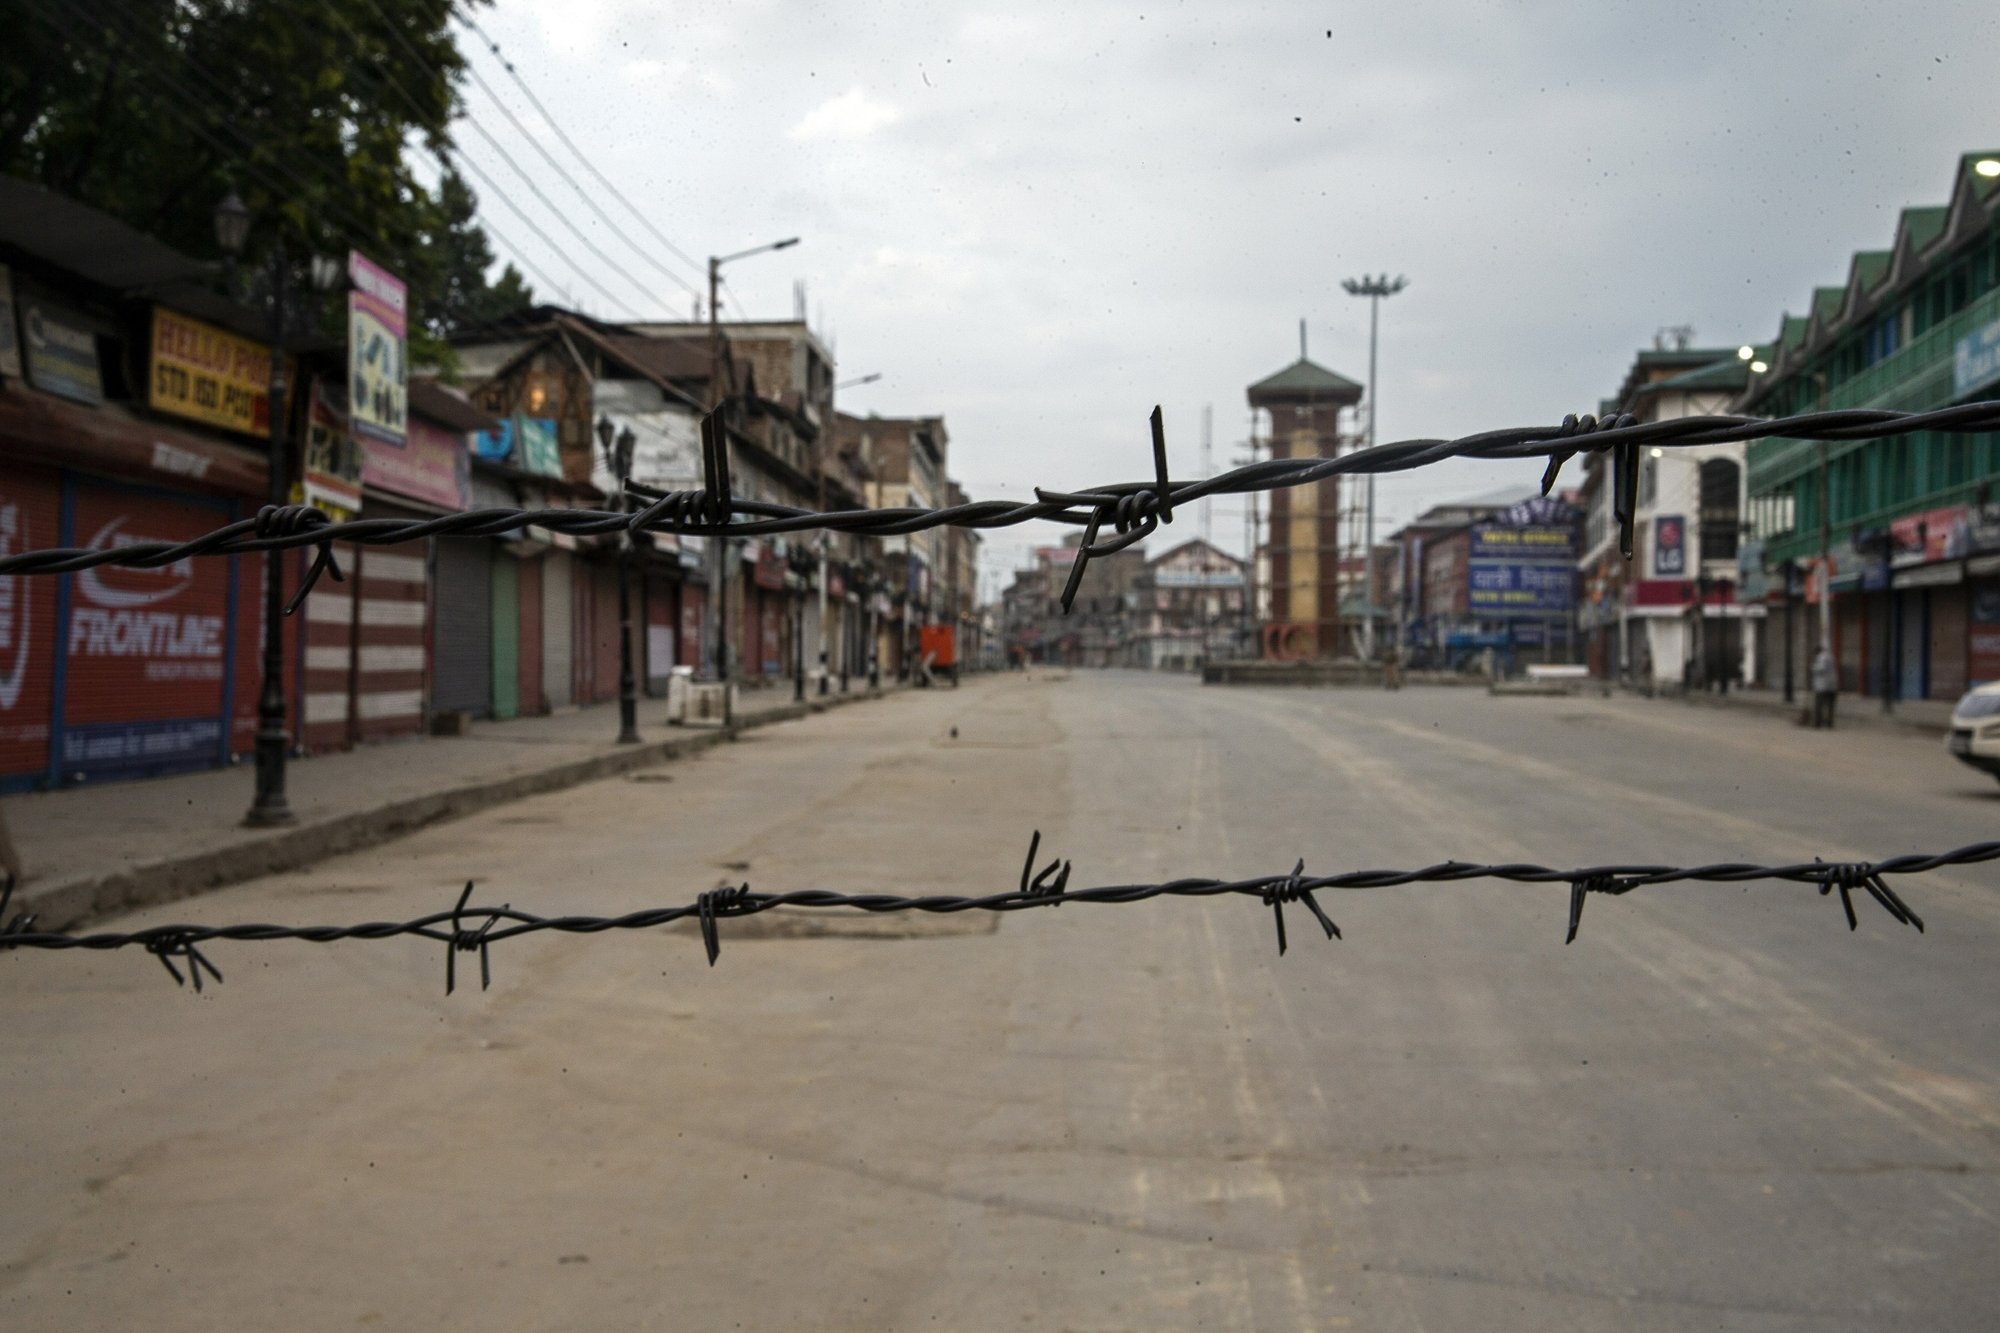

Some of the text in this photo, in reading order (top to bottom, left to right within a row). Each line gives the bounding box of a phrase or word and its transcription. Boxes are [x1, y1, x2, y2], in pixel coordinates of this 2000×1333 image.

[157, 315, 230, 377] HELLO
[157, 362, 251, 418] STD ISD PCO
[1658, 549, 1680, 570] LG
[68, 606, 223, 658] FRONTLINE
